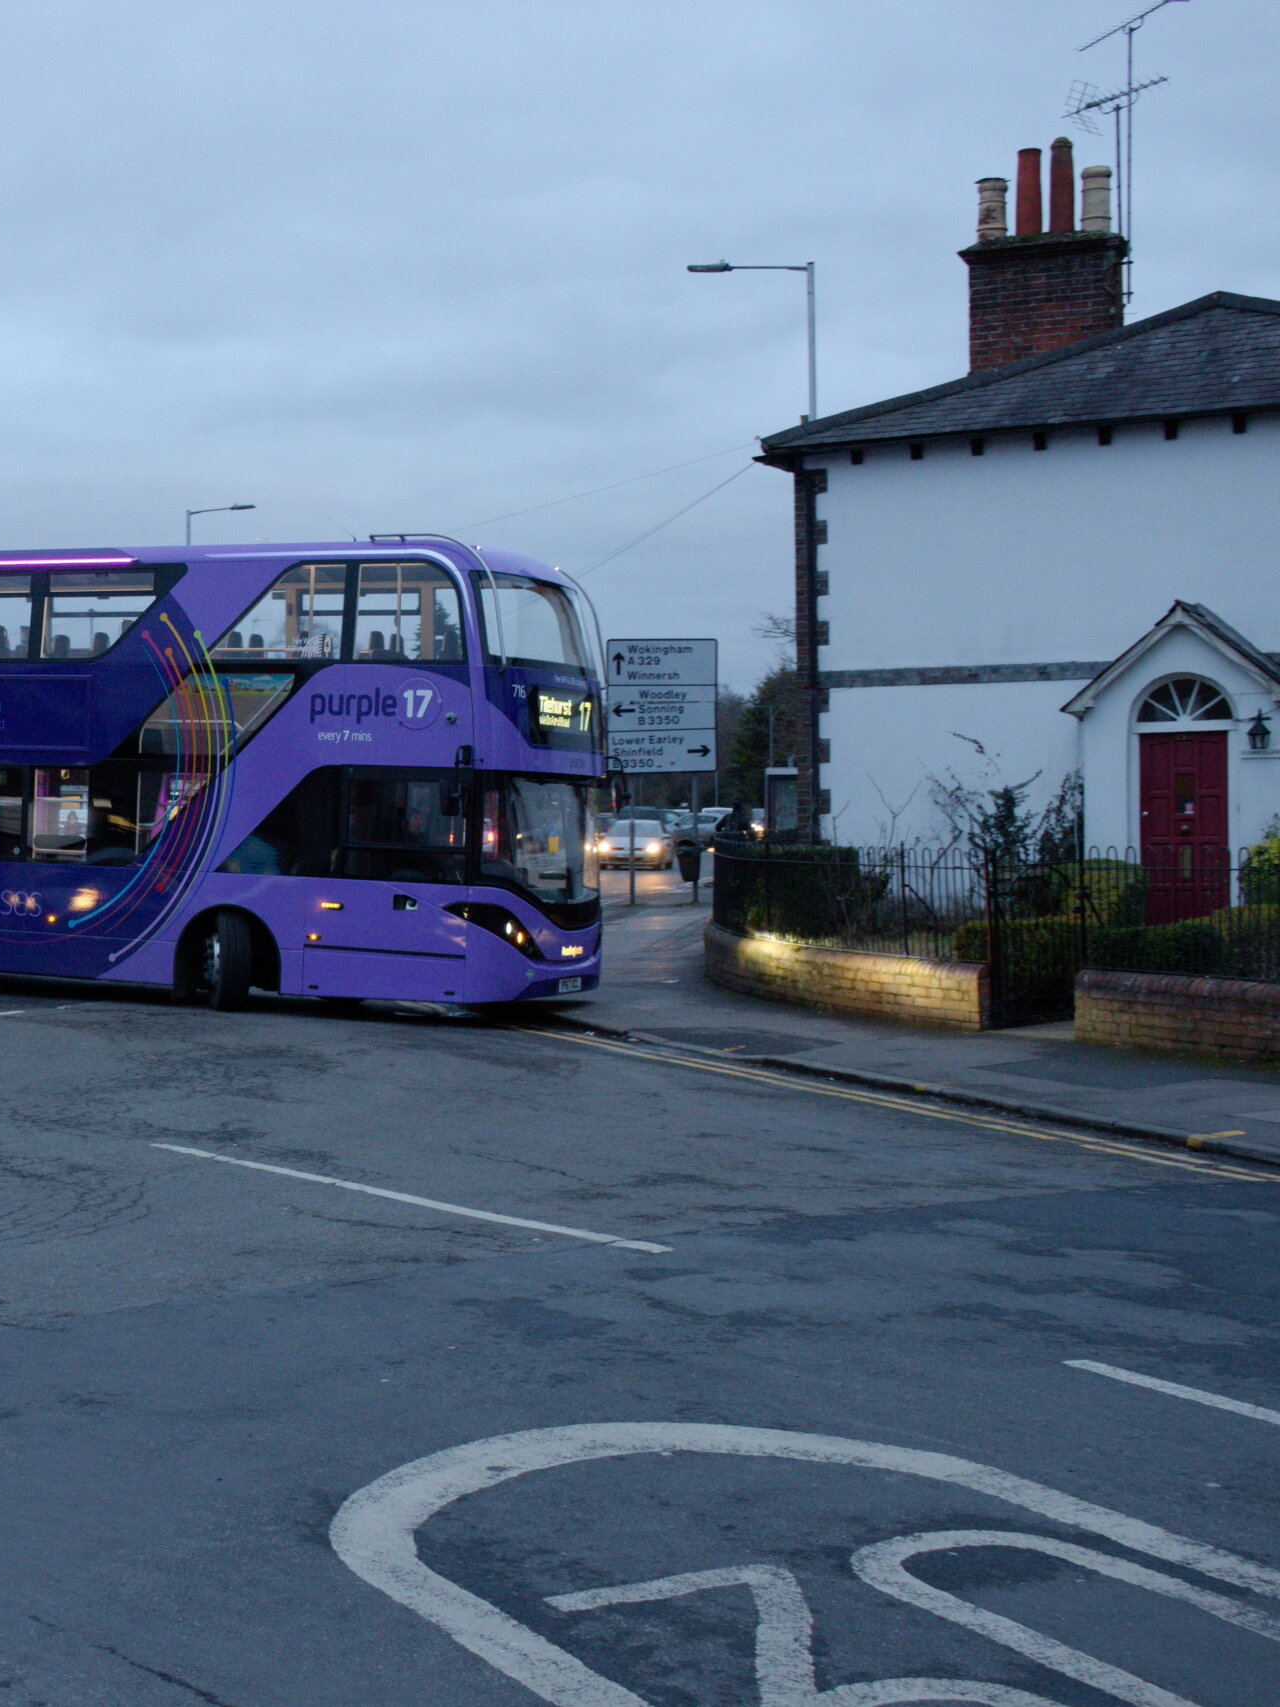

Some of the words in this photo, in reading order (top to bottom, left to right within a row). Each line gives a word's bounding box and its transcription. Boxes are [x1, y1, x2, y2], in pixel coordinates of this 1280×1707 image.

[627, 644, 693, 656] Wokingham
[627, 671, 680, 680] Winnersh
[512, 684, 526, 699] 716
[639, 690, 688, 701] Woodley
[310, 687, 398, 725] purple
[403, 689, 433, 719] 17
[639, 705, 684, 715] Sonning
[579, 701, 592, 731] 17
[318, 731, 342, 744] every
[342, 730, 350, 741] 7
[351, 730, 372, 742] mins
[612, 736, 645, 746] Lower
[649, 735, 684, 746] Earley
[613, 747, 663, 756] Shinfield
